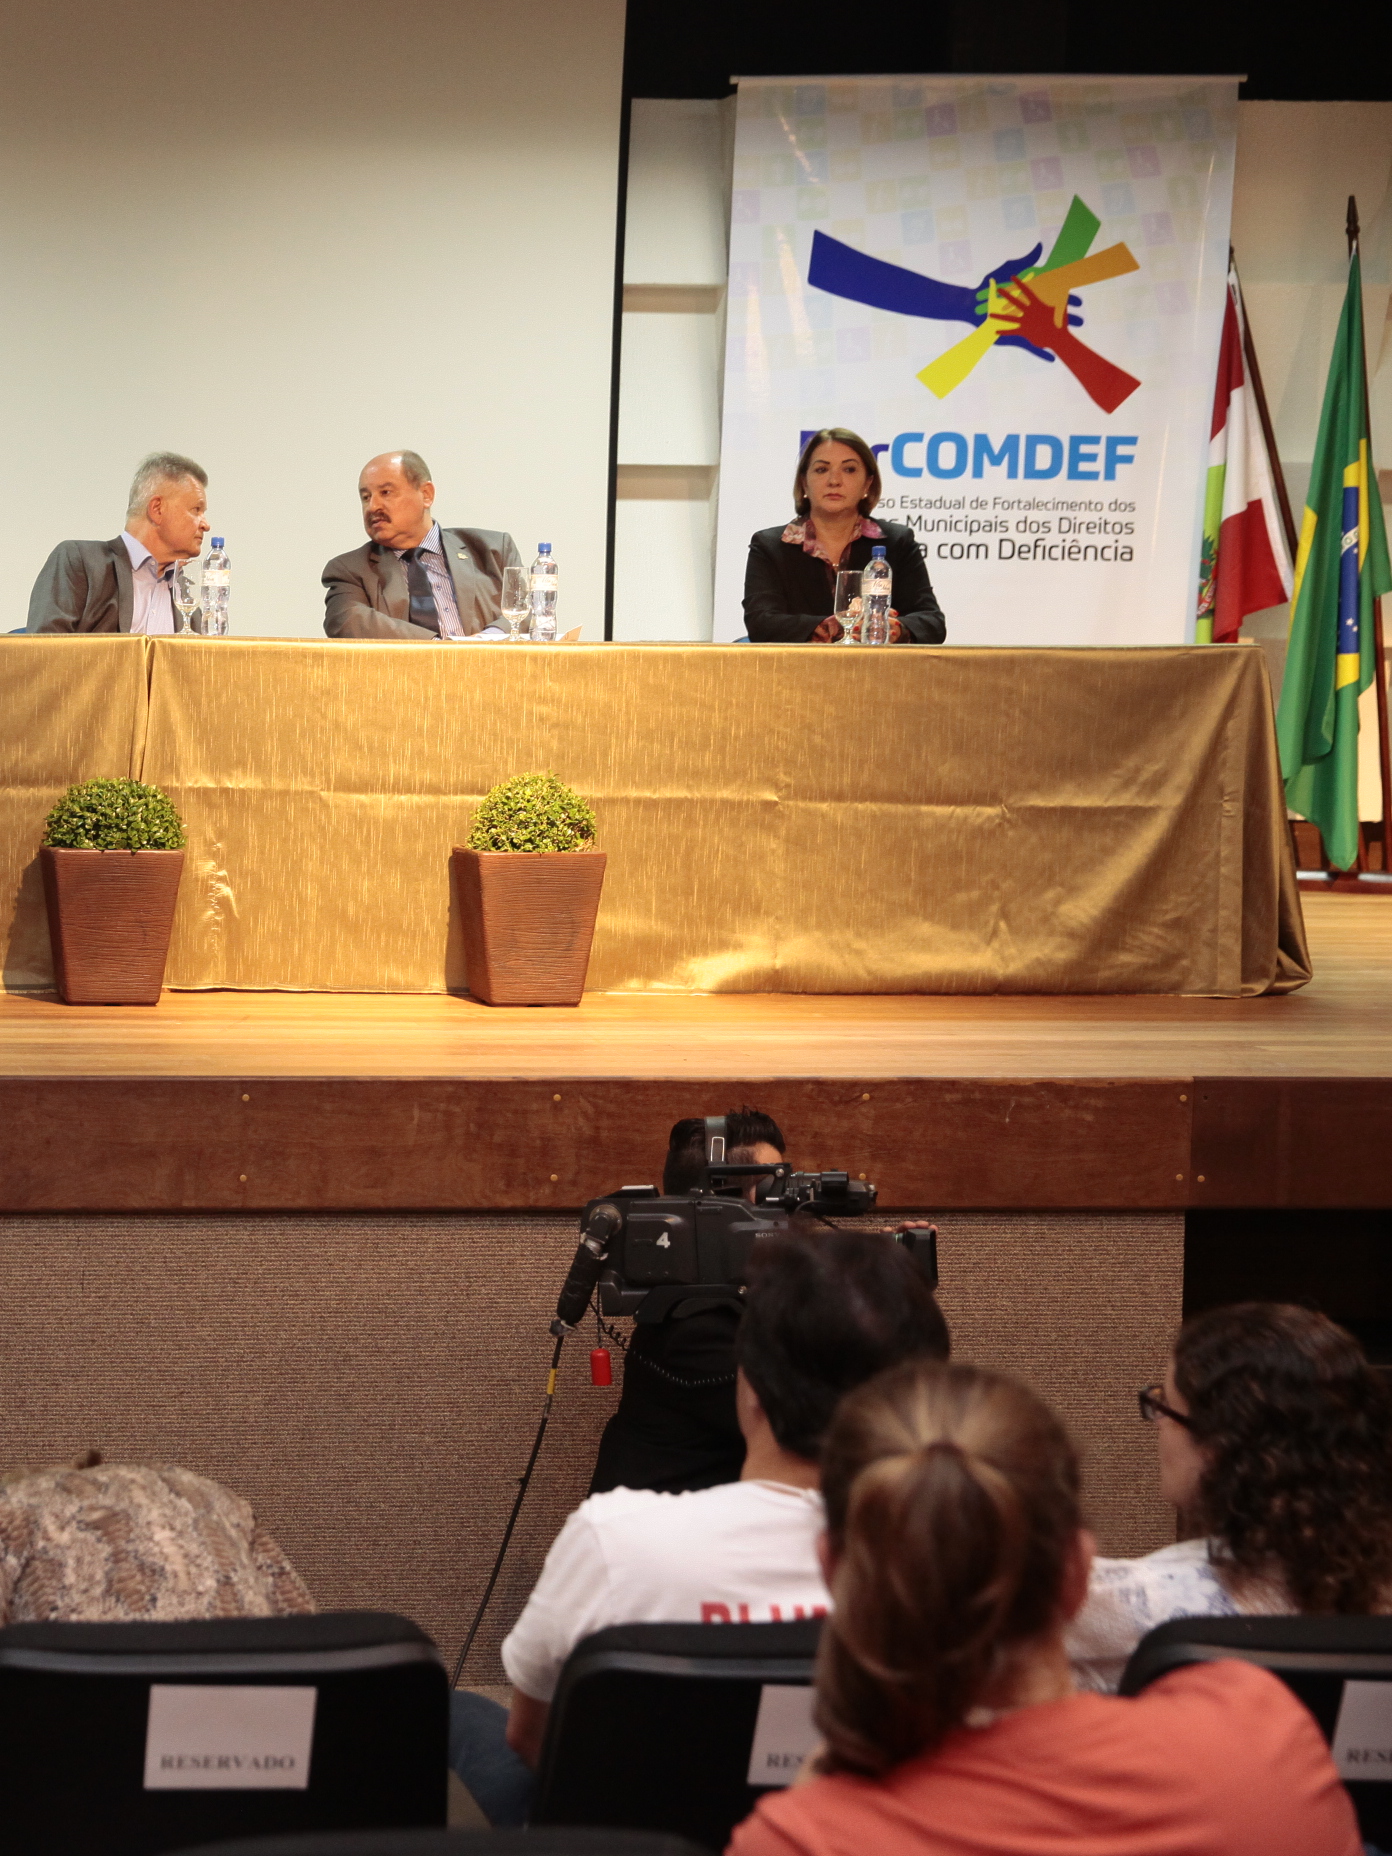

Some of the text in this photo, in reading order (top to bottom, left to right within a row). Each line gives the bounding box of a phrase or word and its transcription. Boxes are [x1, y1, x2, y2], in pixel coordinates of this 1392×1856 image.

[899, 495, 966, 510] Estadual
[969, 496, 989, 511] de
[992, 496, 1104, 513] Fortalecimento
[1107, 498, 1137, 513] dos
[908, 514, 1136, 536] Municipais dos Direitos
[937, 542, 989, 560] com
[998, 537, 1134, 562] Deficiência
[656, 1231, 671, 1249] 4
[160, 1755, 296, 1771] RESERVADO
